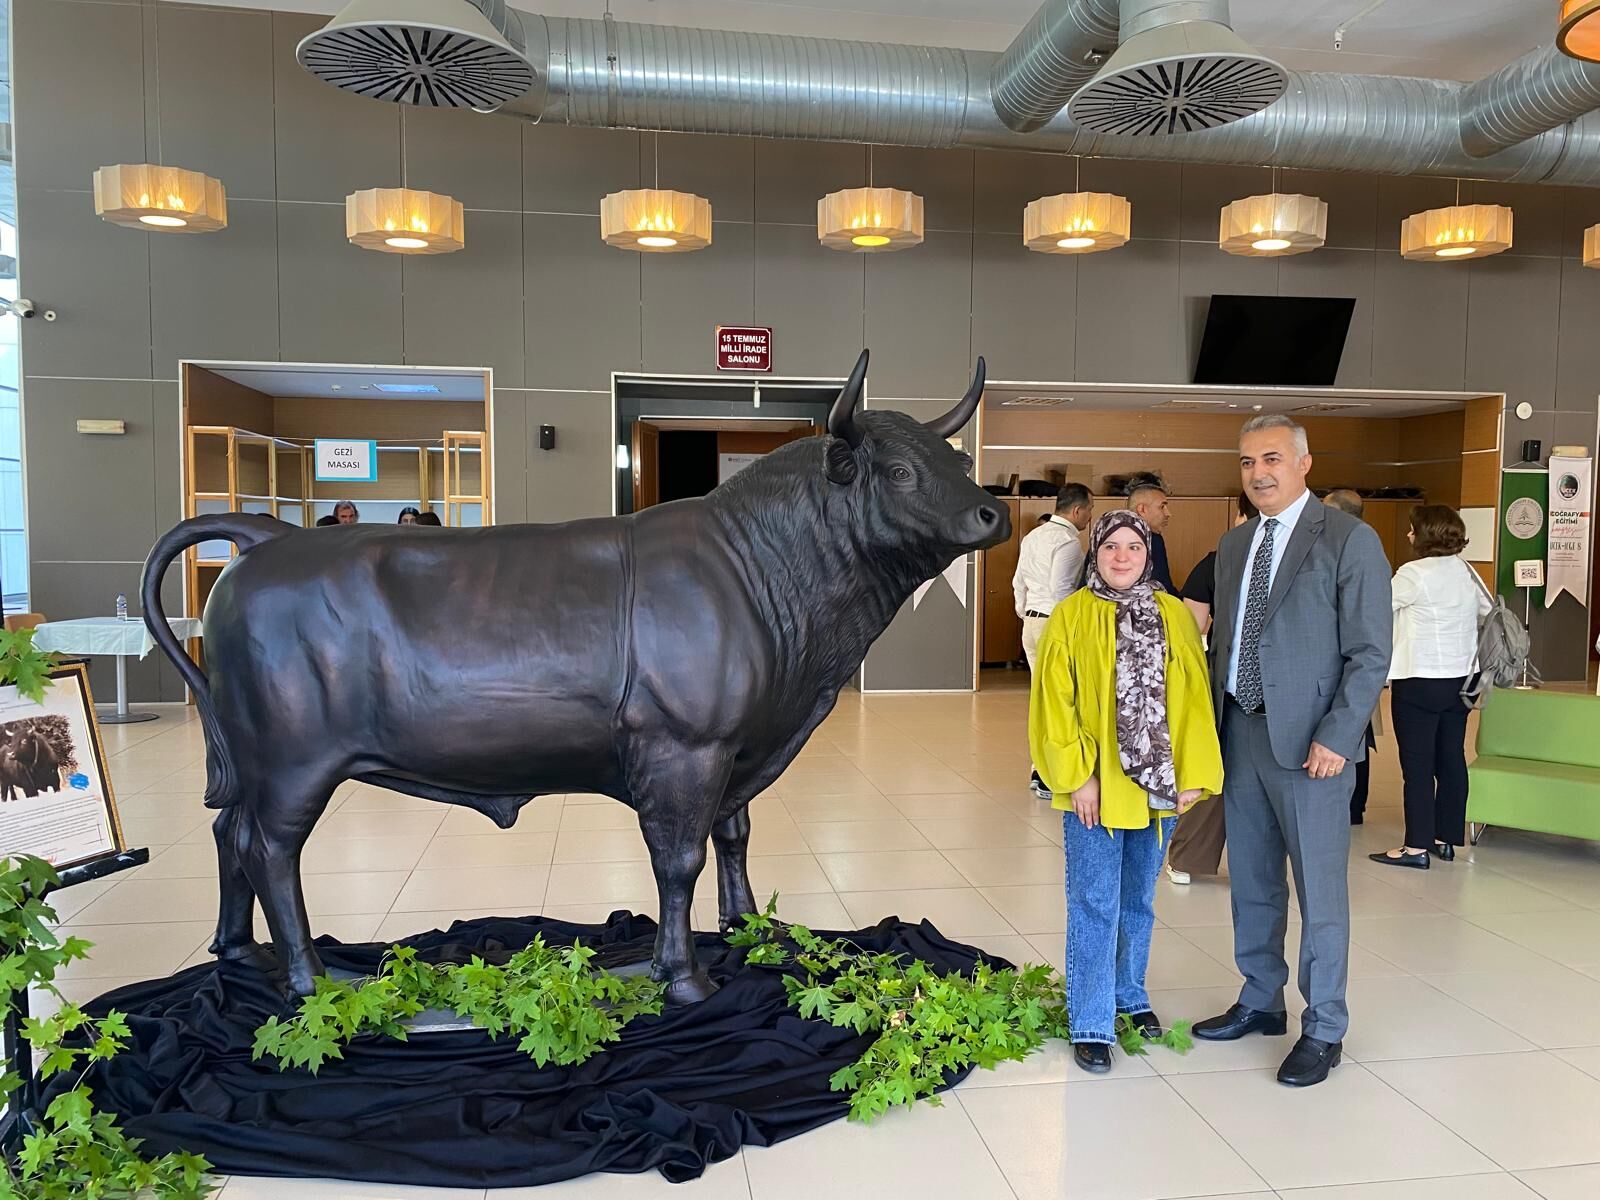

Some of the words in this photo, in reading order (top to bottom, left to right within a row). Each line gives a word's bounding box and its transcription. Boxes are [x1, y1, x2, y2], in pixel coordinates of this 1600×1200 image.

[733, 335, 766, 343] TEMMUZ
[721, 343, 741, 352] MİLLİ
[743, 343, 767, 354] İRADE
[728, 355, 760, 363] SALONU
[334, 446, 352, 456] GEZİ
